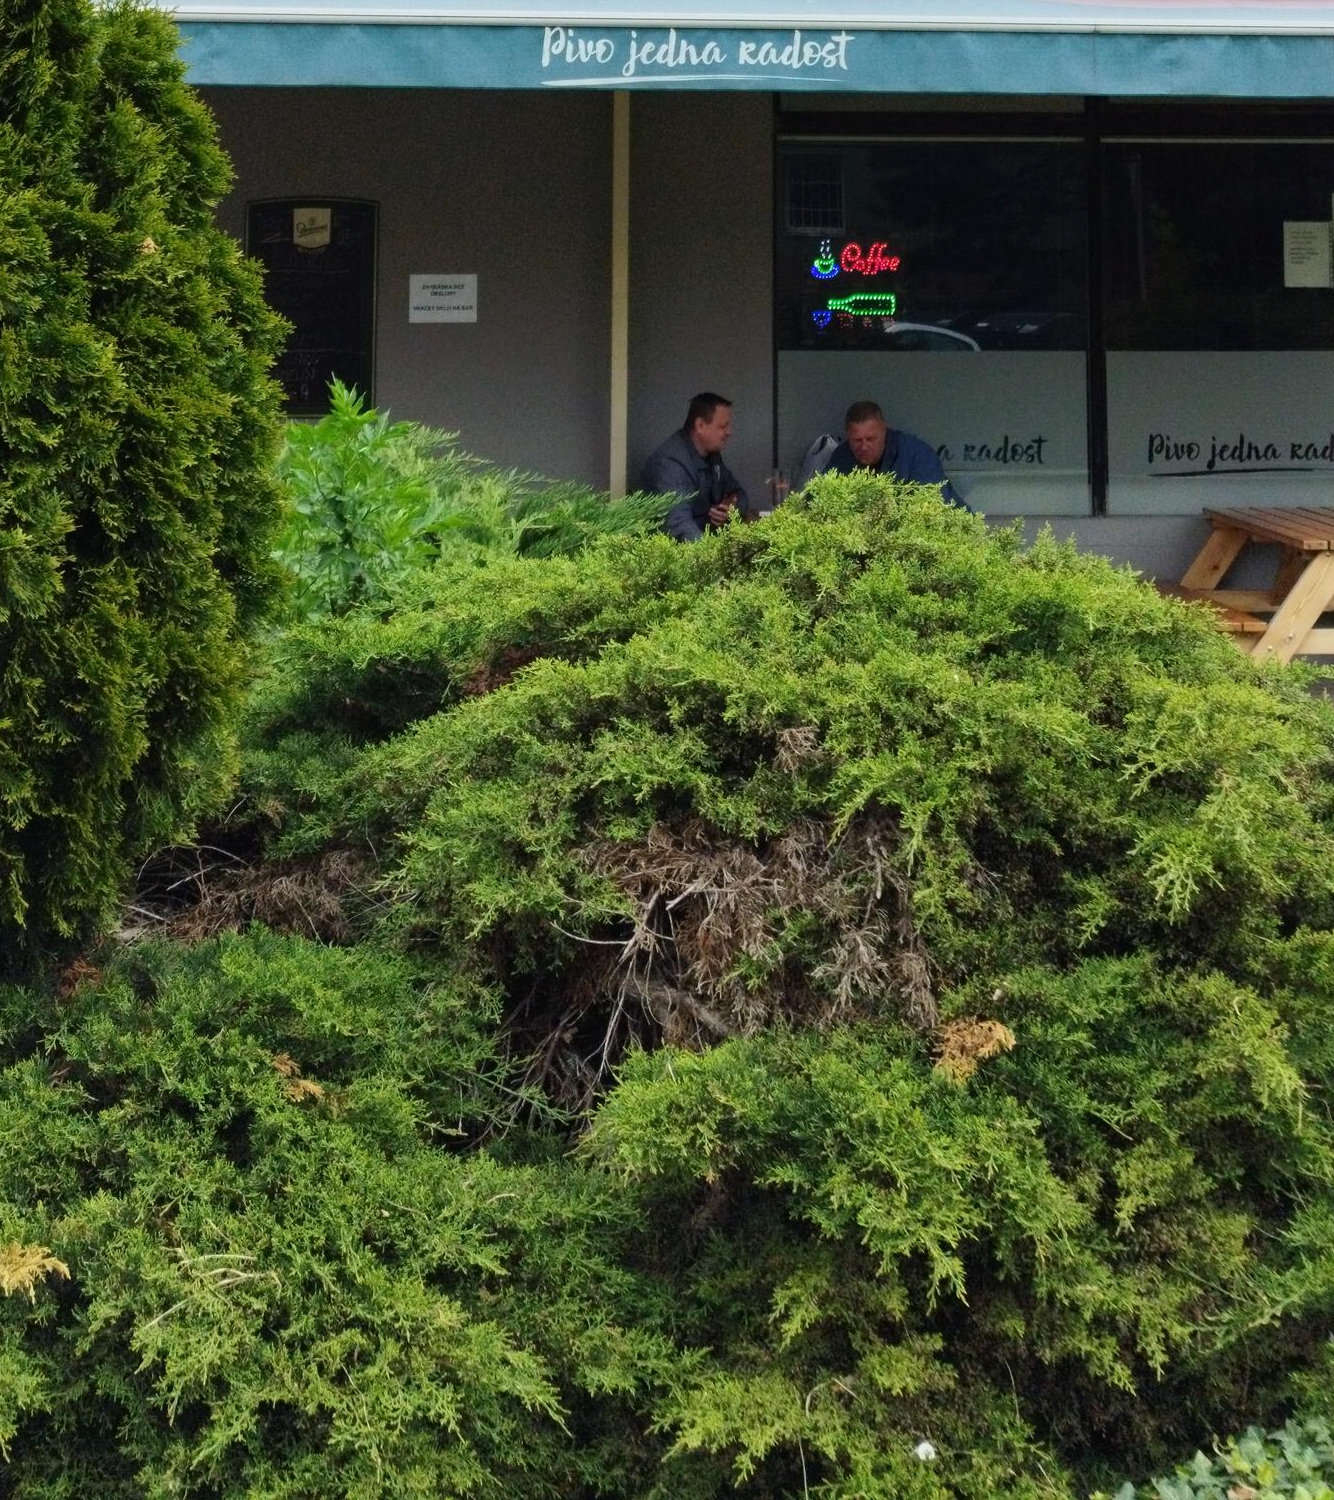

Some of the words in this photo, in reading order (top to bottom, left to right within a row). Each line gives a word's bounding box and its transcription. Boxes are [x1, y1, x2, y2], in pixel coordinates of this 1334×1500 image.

[542, 26, 615, 68] Pivo
[622, 27, 727, 77] jedna
[840, 242, 901, 275] Coffee
[1148, 433, 1200, 463] Pivo
[1206, 433, 1282, 470] jedna
